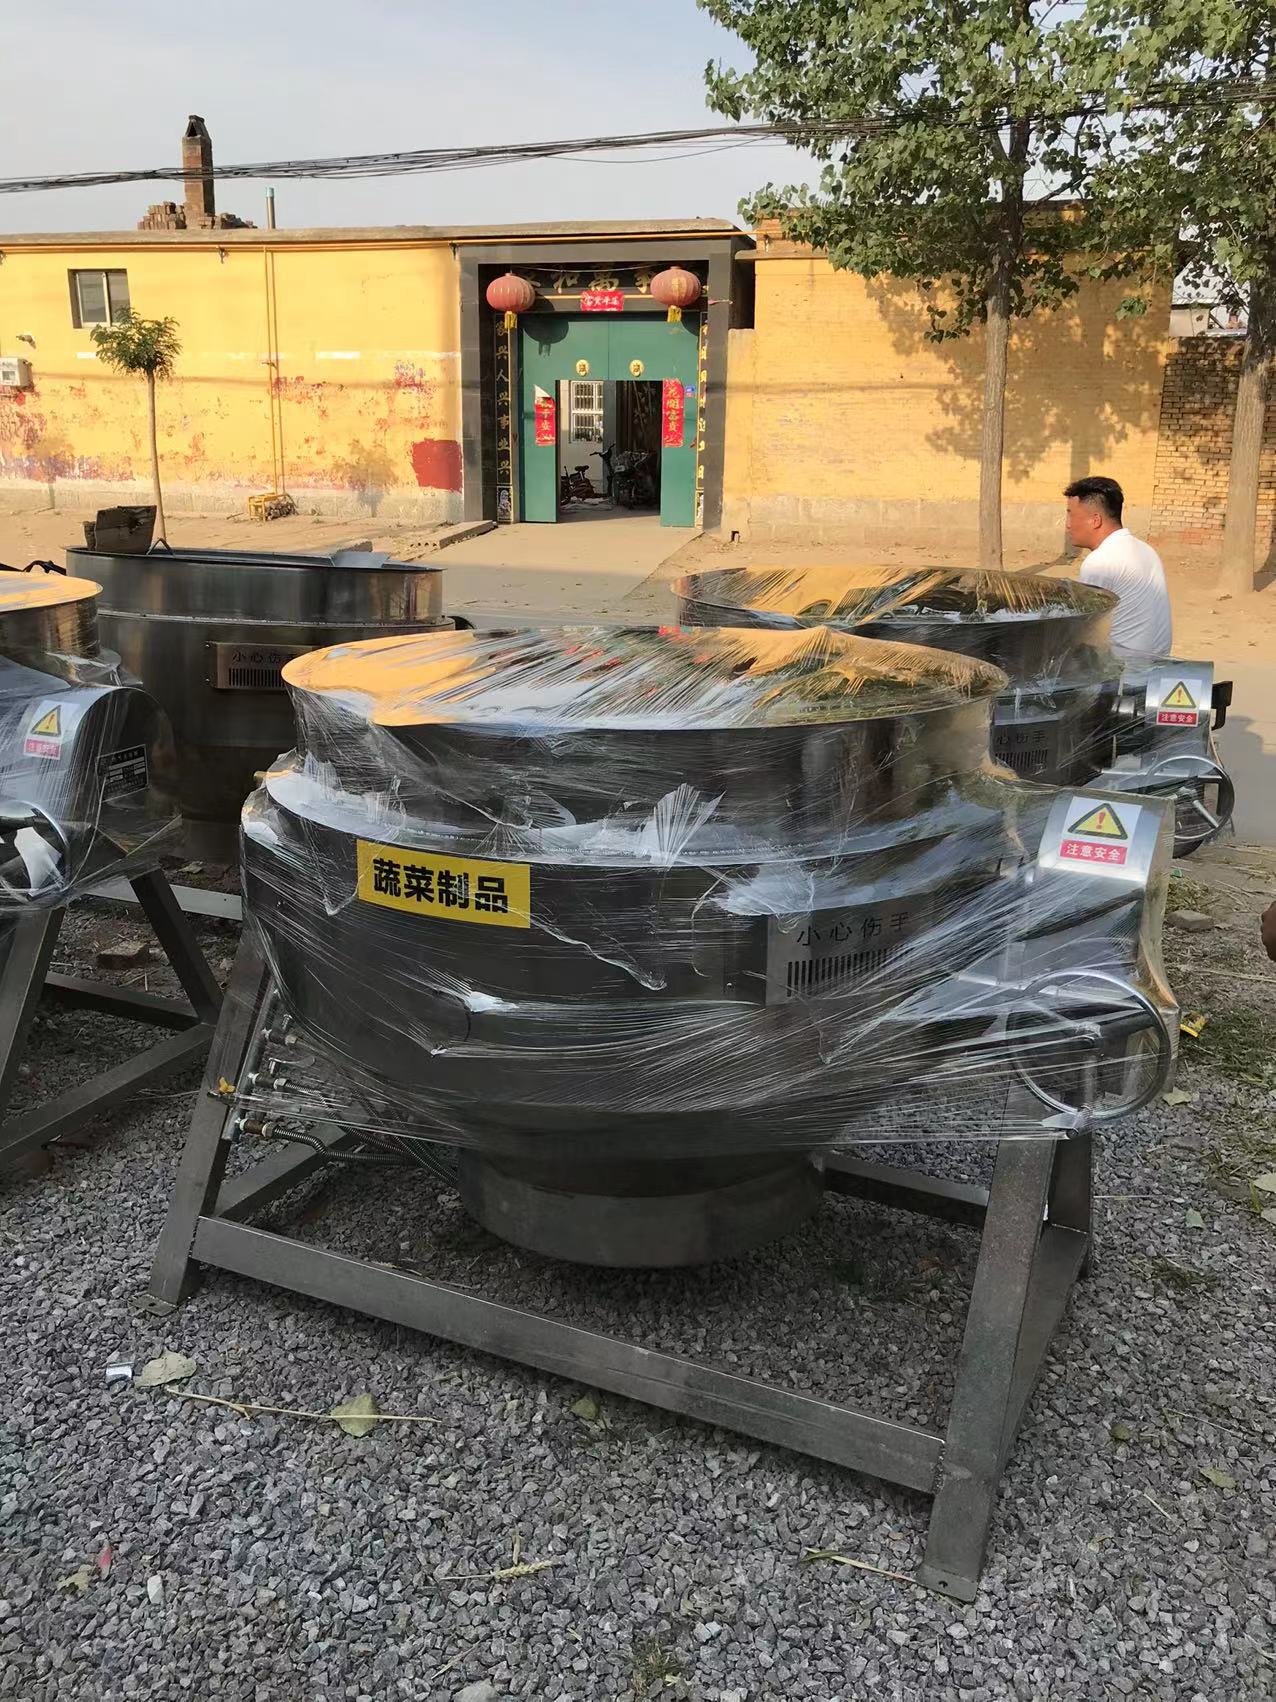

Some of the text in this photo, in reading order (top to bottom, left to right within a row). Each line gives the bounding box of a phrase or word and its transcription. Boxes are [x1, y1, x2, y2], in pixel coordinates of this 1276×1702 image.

[1161, 711, 1194, 725] 注意安全
[1066, 842, 1122, 863] 注意安全
[372, 857, 508, 914] 蔬菜制品
[796, 911, 910, 947] 小心伤手
